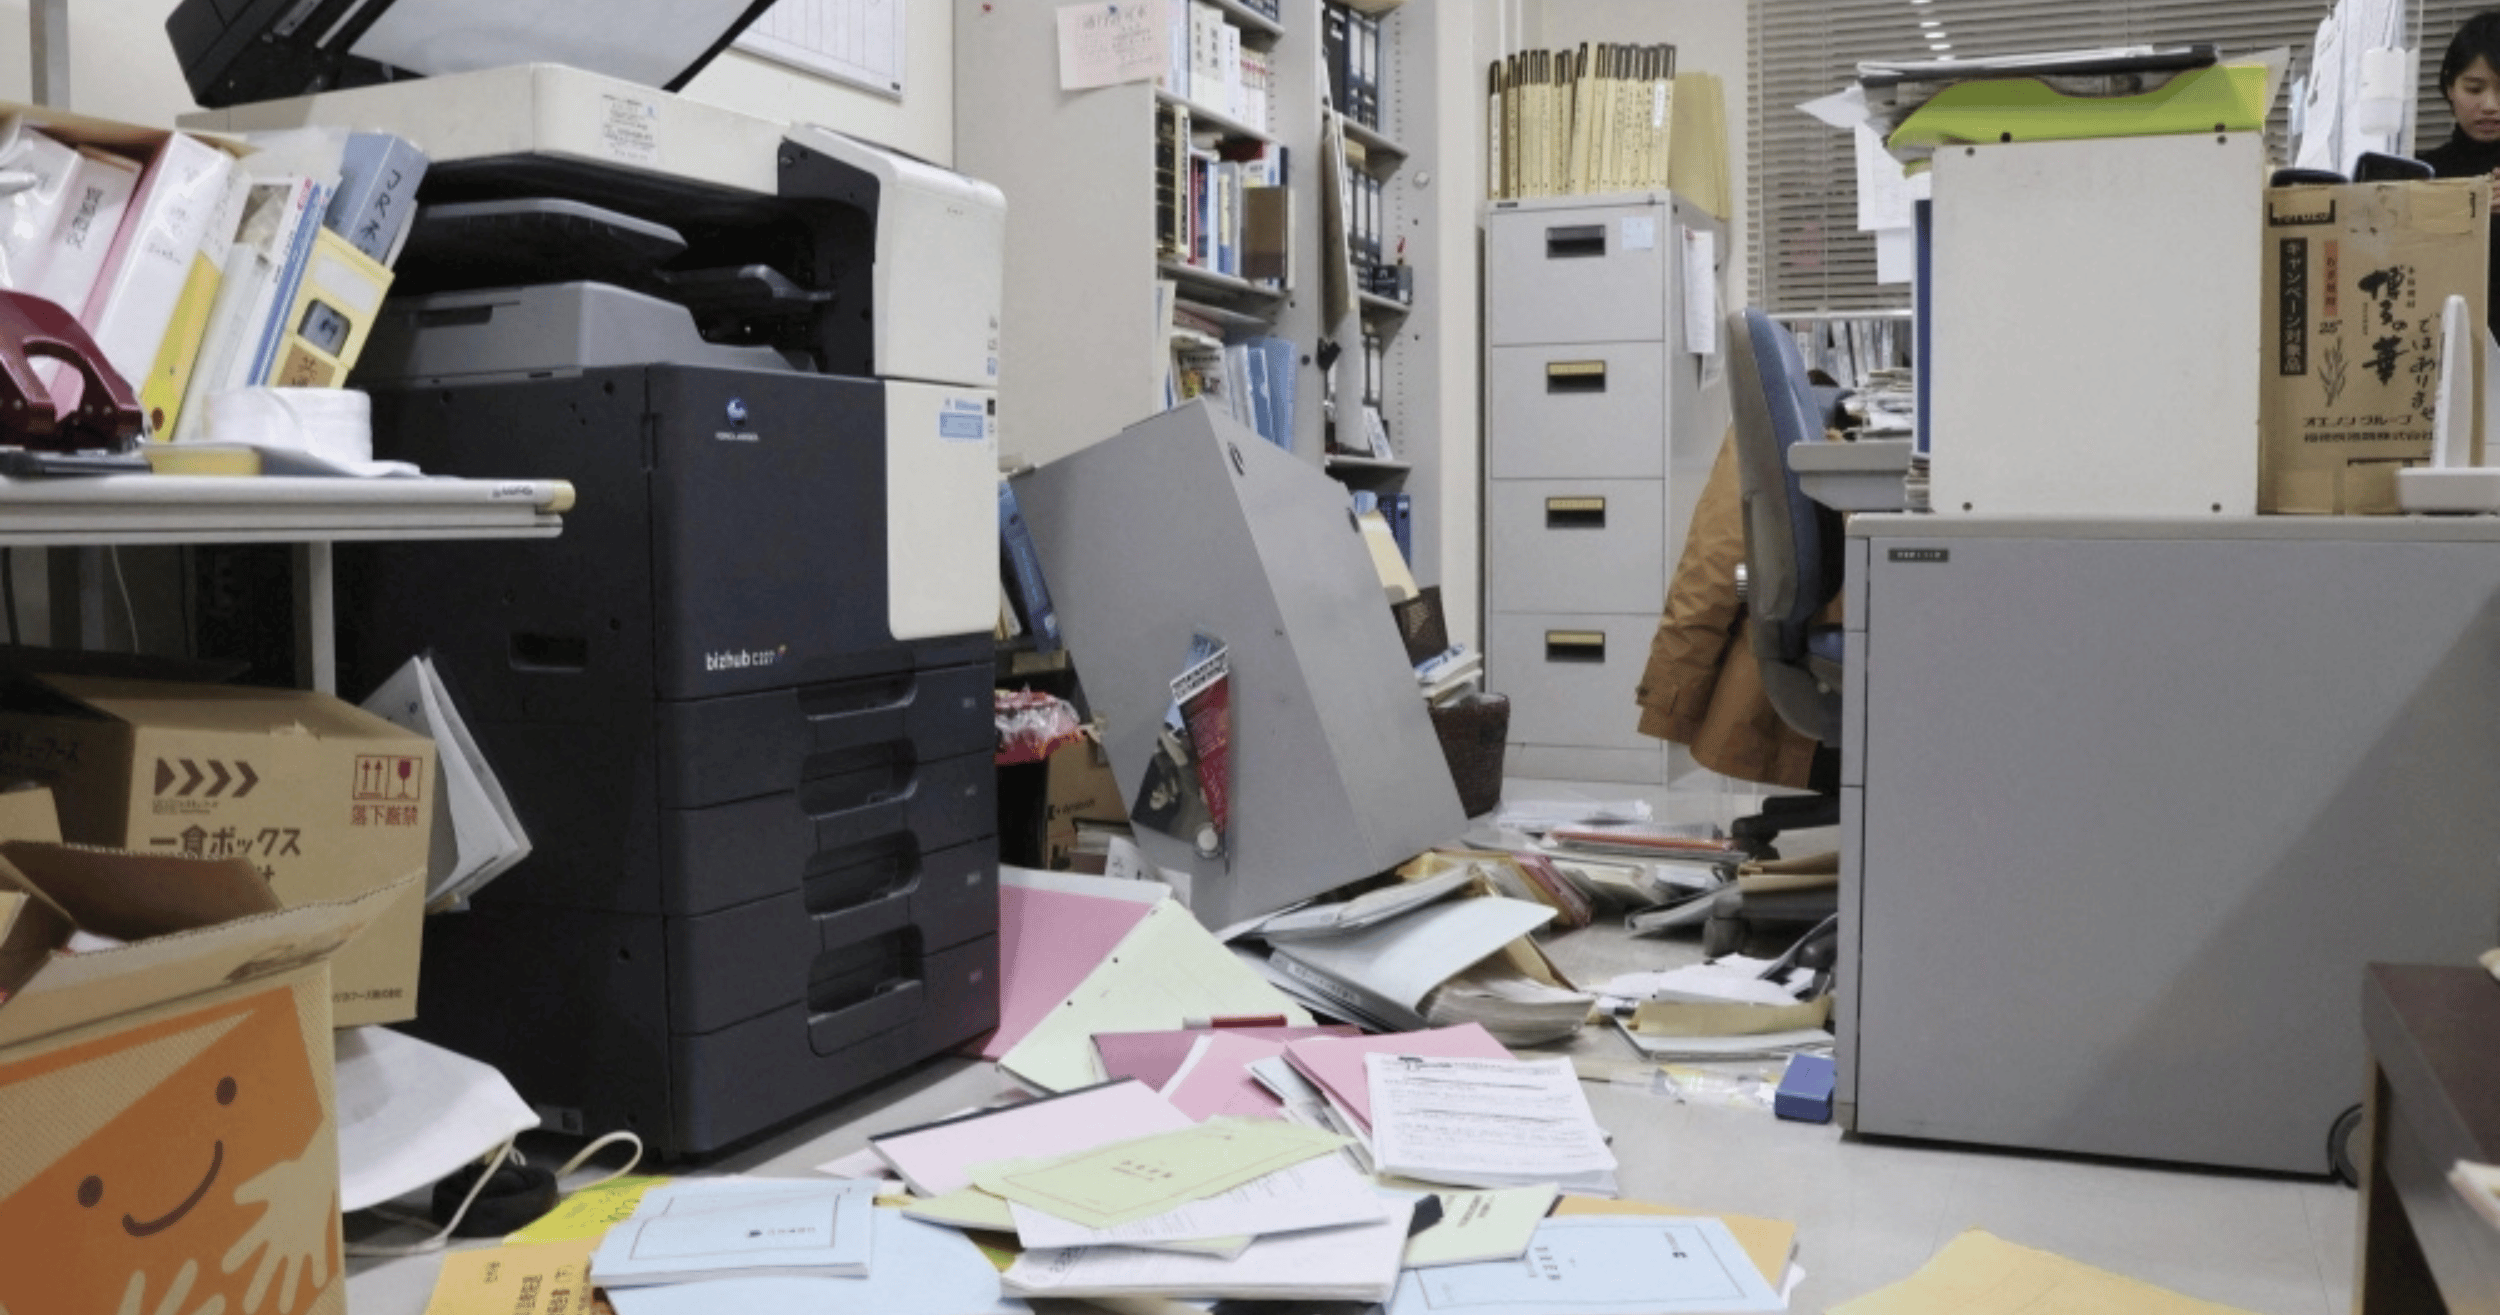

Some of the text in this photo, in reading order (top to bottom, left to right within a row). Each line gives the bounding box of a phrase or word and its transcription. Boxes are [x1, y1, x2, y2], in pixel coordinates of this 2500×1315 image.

[2282, 241, 2303, 374] キャンペーン対象品
[705, 648, 751, 671] bizhub
[350, 804, 419, 828] 落下厳禁
[149, 824, 302, 858] 一食ボックス
